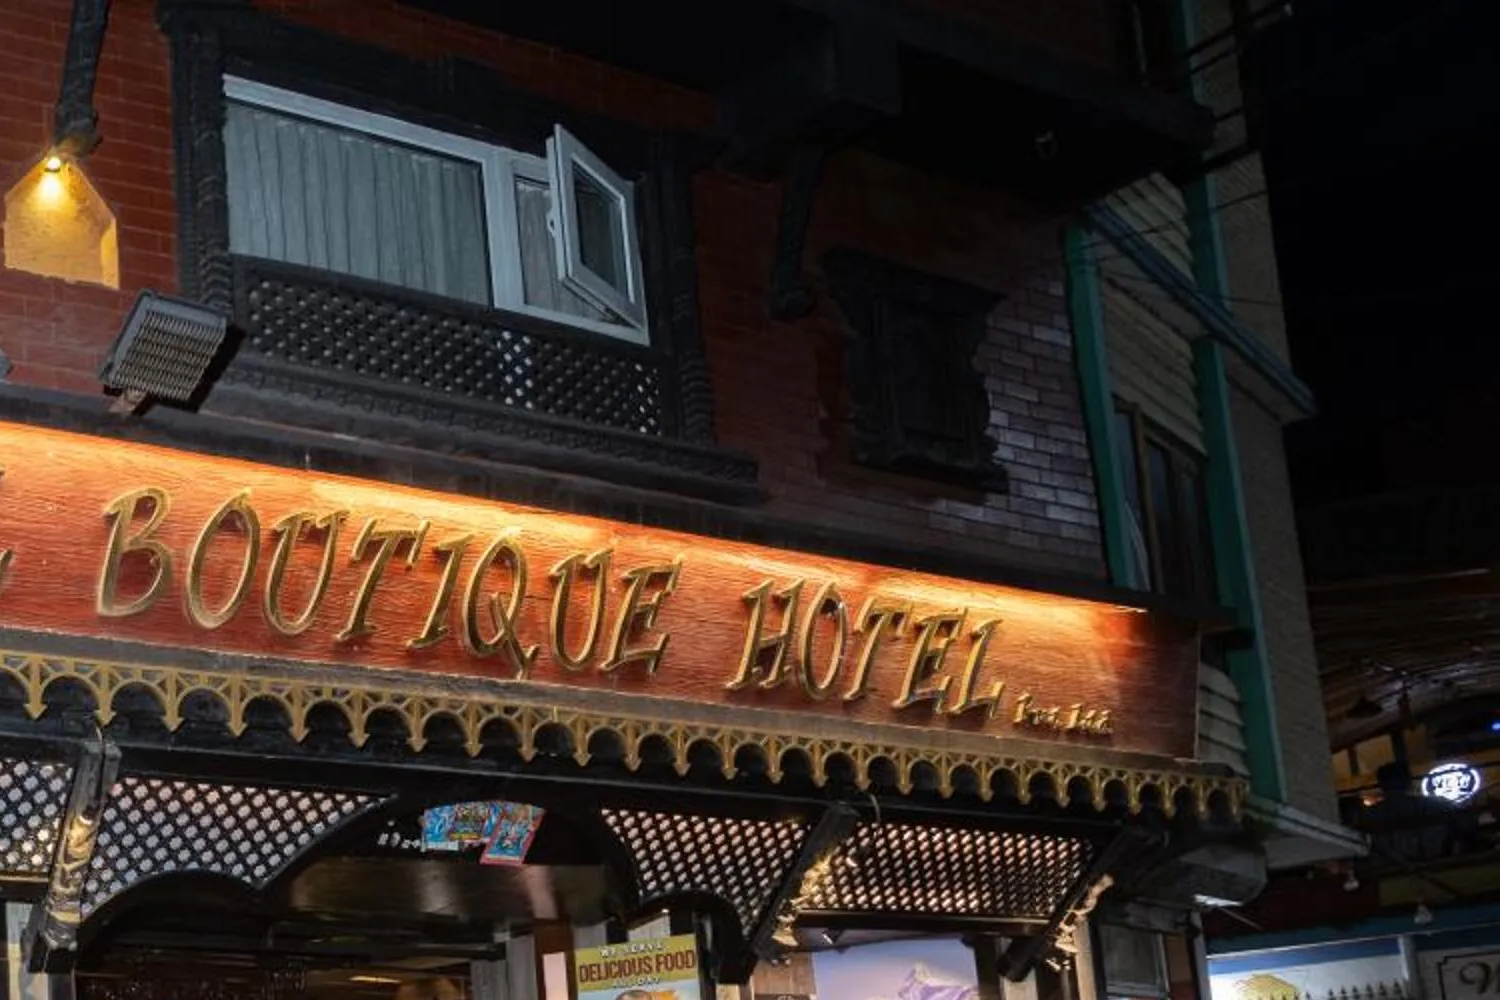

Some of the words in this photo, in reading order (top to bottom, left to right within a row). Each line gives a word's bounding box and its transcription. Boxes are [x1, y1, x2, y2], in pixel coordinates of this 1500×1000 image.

[96, 486, 686, 681] BOUTIQUE
[724, 577, 1004, 720] HOTEL
[579, 955, 653, 984] DELICIOUS
[655, 949, 695, 974] FOOD
